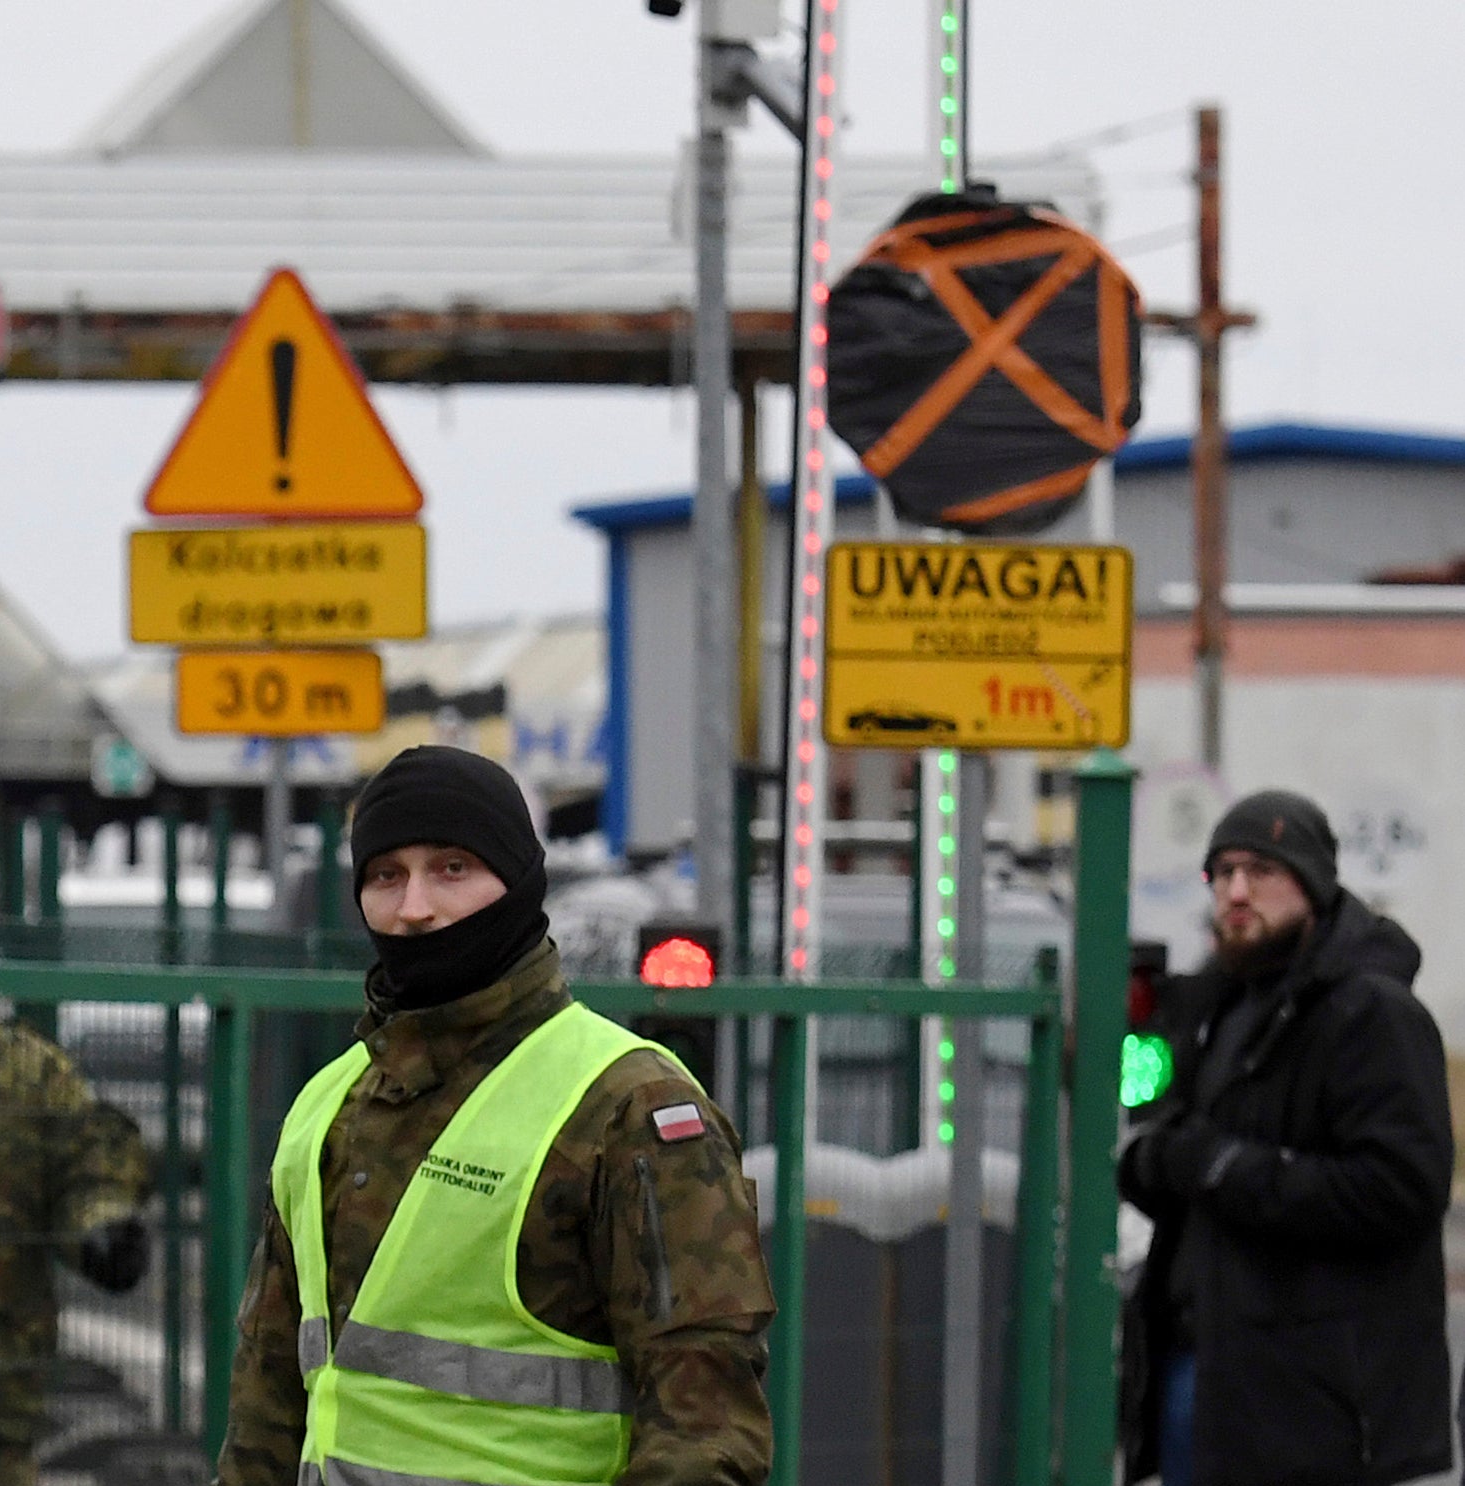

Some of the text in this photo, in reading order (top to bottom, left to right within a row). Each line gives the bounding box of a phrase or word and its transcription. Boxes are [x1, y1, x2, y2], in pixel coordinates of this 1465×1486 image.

[848, 549, 1108, 601] UWAGA!
[215, 665, 352, 719] 30 m
[982, 673, 1056, 717] 1m
